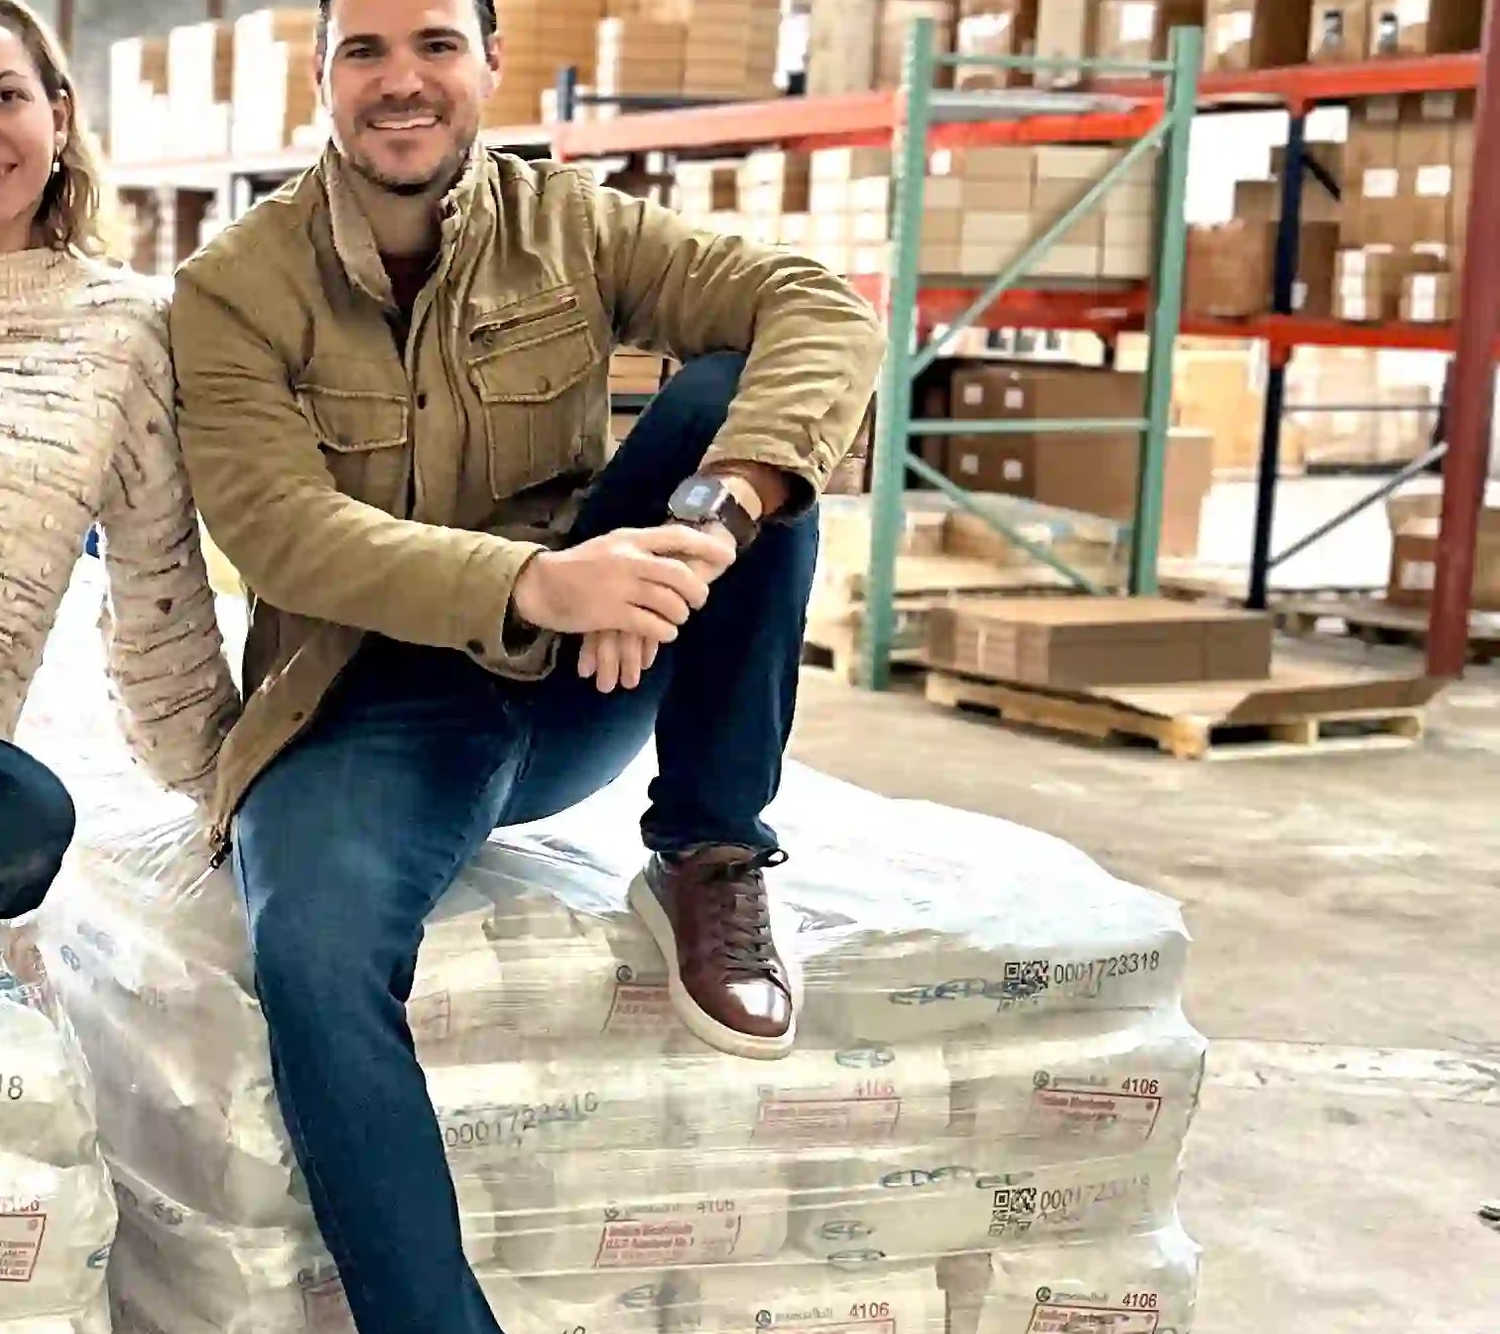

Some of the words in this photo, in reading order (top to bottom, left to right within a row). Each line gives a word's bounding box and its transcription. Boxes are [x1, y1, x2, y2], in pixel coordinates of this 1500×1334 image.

[1054, 950, 1160, 985] 0001723318
[1122, 1078, 1159, 1094] 4106
[1122, 1293, 1157, 1307] 4106
[850, 1302, 890, 1318] 4106
